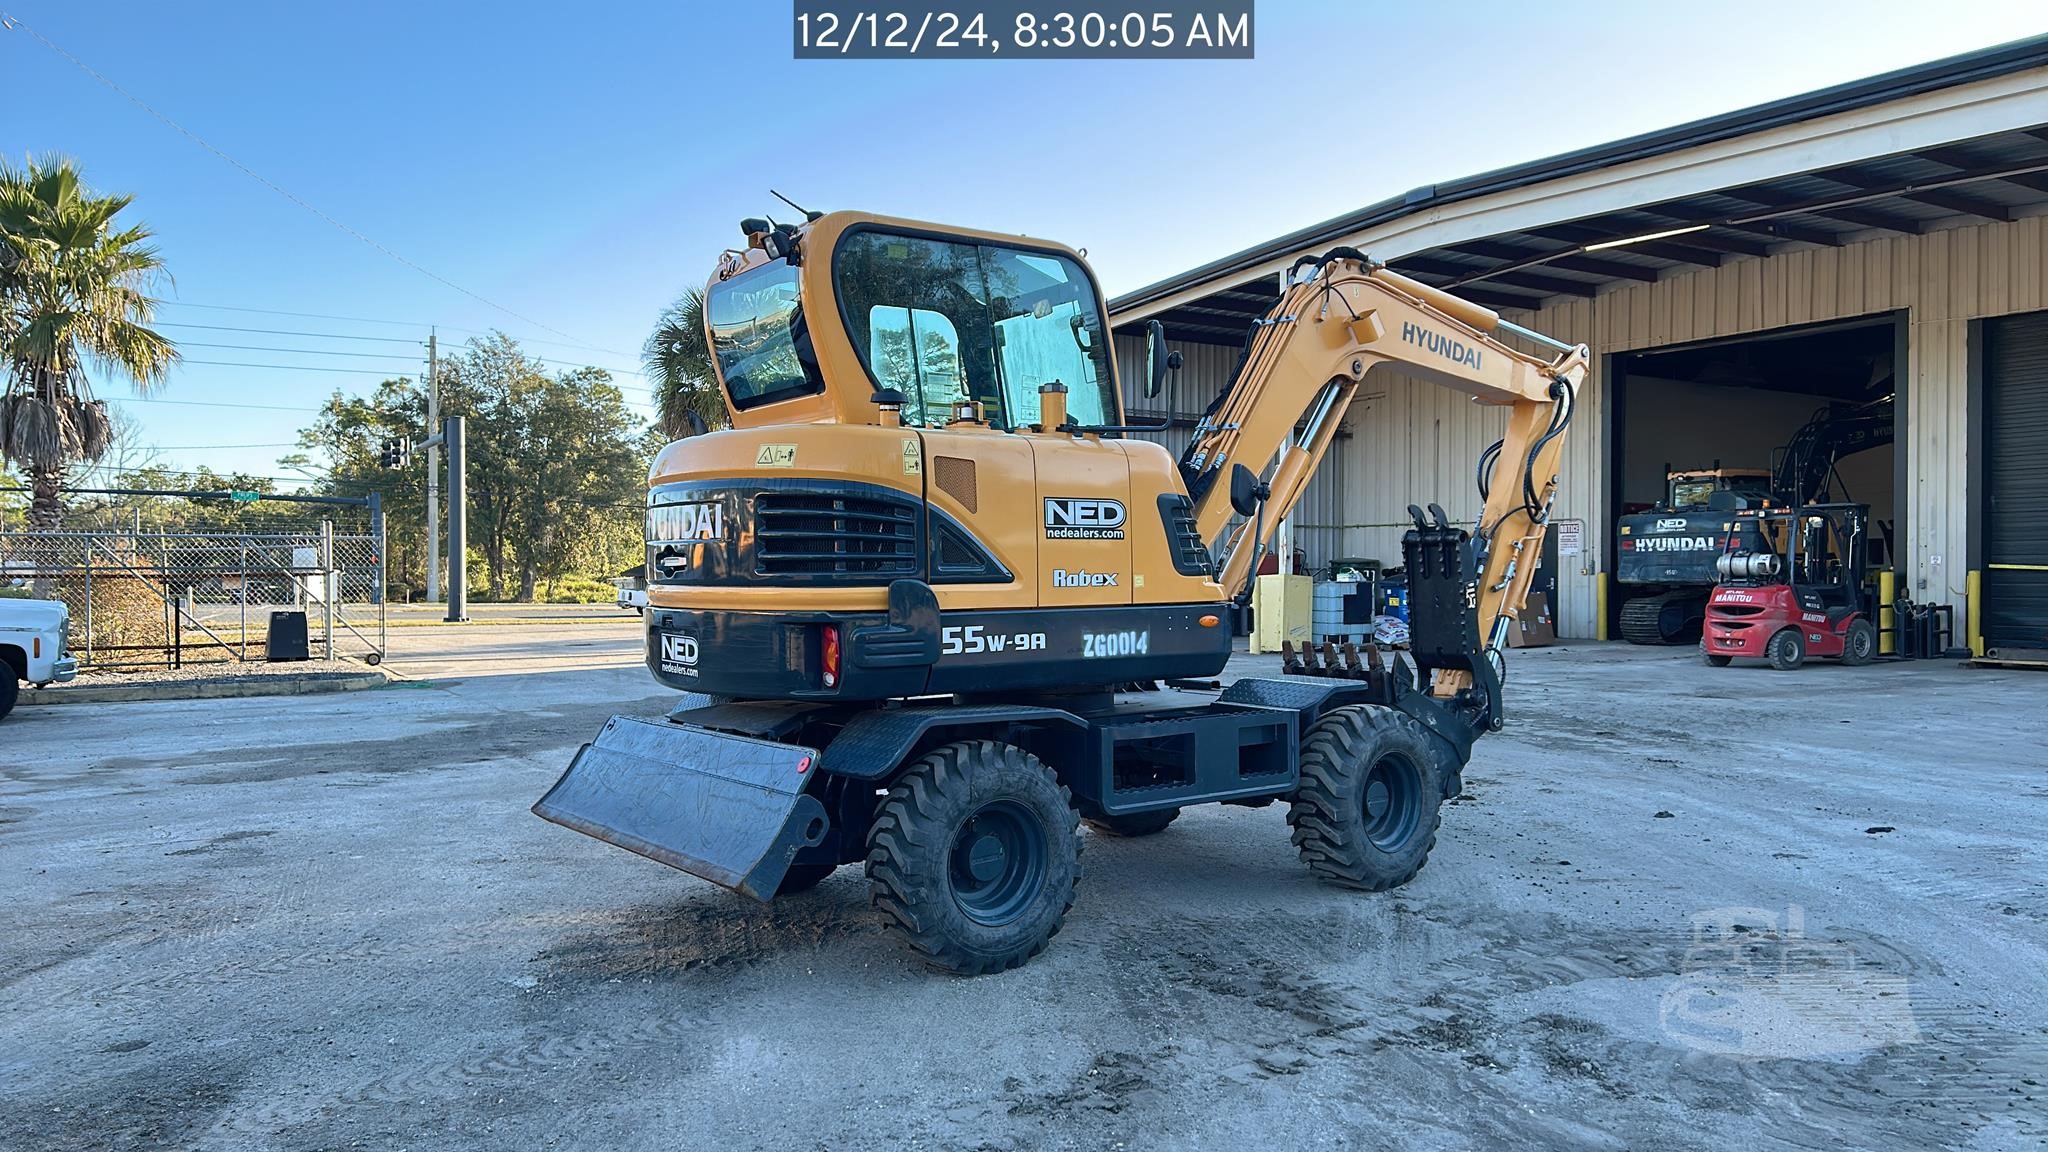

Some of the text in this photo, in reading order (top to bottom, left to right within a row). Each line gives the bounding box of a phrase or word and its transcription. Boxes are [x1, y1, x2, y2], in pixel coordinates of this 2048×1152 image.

[1402, 320, 1482, 370] HYUNDAI
[1046, 499, 1125, 526] NED
[1656, 518, 1687, 528] NED
[1047, 527, 1124, 538] nedealers.com
[1635, 537, 1714, 552] HYUNDAI
[1053, 568, 1119, 587] Robex
[1714, 594, 1753, 603] MANITOU
[661, 634, 699, 664] NED
[1083, 631, 1148, 658] ZG0014
[661, 663, 699, 678] nedealers.com
